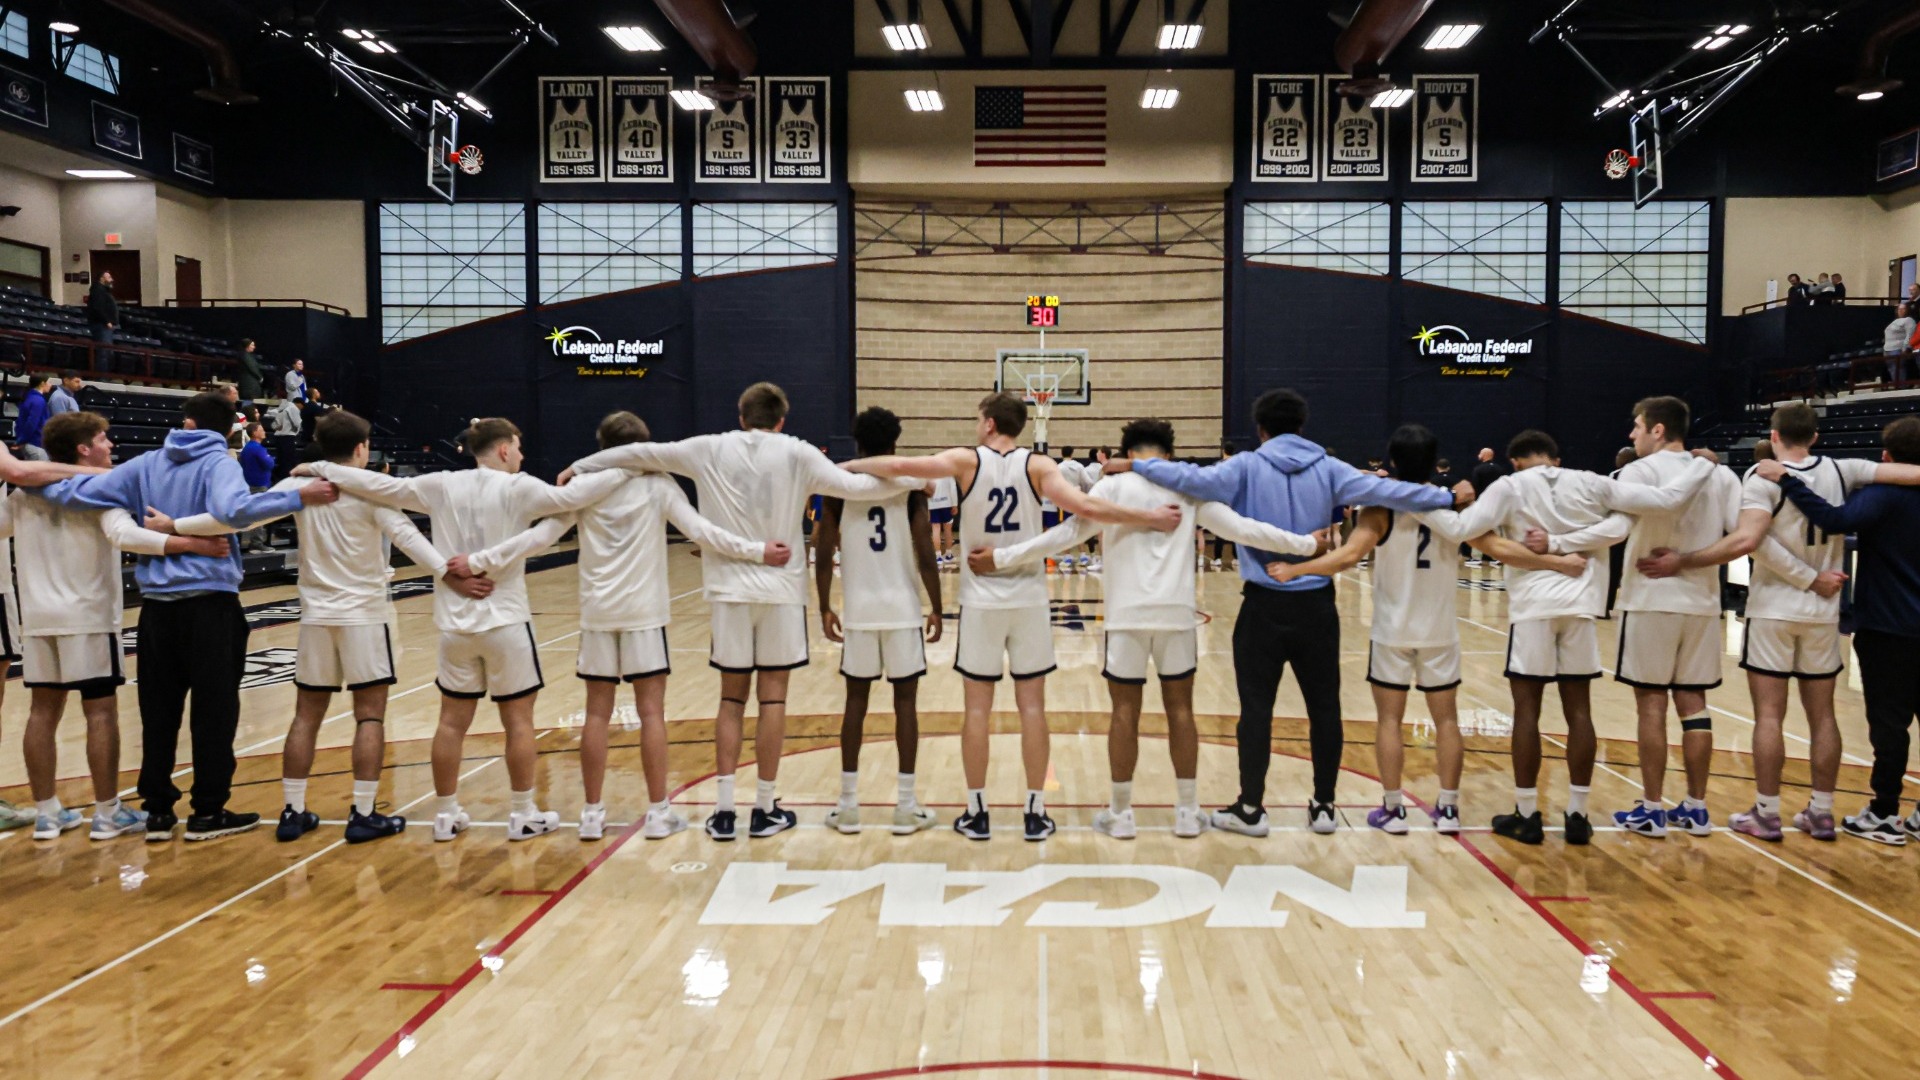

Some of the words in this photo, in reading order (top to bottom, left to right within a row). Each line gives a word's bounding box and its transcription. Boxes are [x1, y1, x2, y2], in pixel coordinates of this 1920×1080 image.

[549, 83, 594, 97] LANDA
[615, 84, 665, 96] JOHNSON
[780, 85, 816, 97] PANKO
[1269, 82, 1303, 94] TIGHE
[1424, 82, 1467, 94] HOOVER
[553, 120, 589, 131] LEBANON
[622, 120, 658, 131] LEBANON
[710, 120, 746, 131] LEBANON
[780, 120, 815, 131] LEBANON
[1268, 118, 1303, 129] LEBANON
[1338, 118, 1374, 129] LEBANON
[1427, 118, 1463, 129] LEBANON
[563, 131, 580, 148] 11
[628, 131, 653, 148] 40
[722, 131, 734, 148] 5
[786, 131, 811, 148] 33
[1272, 128, 1299, 147] 22
[1343, 128, 1369, 147] 23
[1439, 128, 1451, 147] 5
[556, 150, 587, 160] VALLEY
[624, 150, 655, 160] VALLEY
[712, 150, 743, 160] VALLEY
[782, 150, 813, 160] VALLEY
[1269, 149, 1301, 158] VALLEY
[1339, 149, 1371, 158] VALLEY
[1429, 149, 1460, 158] VALLEY
[550, 165, 595, 175] 1951-1955
[617, 165, 664, 175] 1969-1973
[705, 165, 751, 175] 1991-1995
[774, 165, 821, 175] 1995-1999
[1260, 164, 1310, 174] 1999-2003
[1330, 164, 1381, 174] 2001-2005
[1420, 164, 1468, 174] 2007-2011
[1031, 307, 1054, 326] 30
[562, 339, 615, 355] Lebanon
[617, 339, 663, 355] Federal
[1429, 339, 1482, 354] Lebanon
[1485, 339, 1533, 354] Federal
[589, 354, 614, 363] Credit
[614, 354, 638, 363] Union
[1457, 353, 1481, 363] Credit
[1482, 353, 1506, 363] Union
[984, 486, 1020, 533] 22
[867, 506, 887, 552] 3
[1416, 523, 1431, 569] 2
[697, 861, 1426, 928] NCAA
